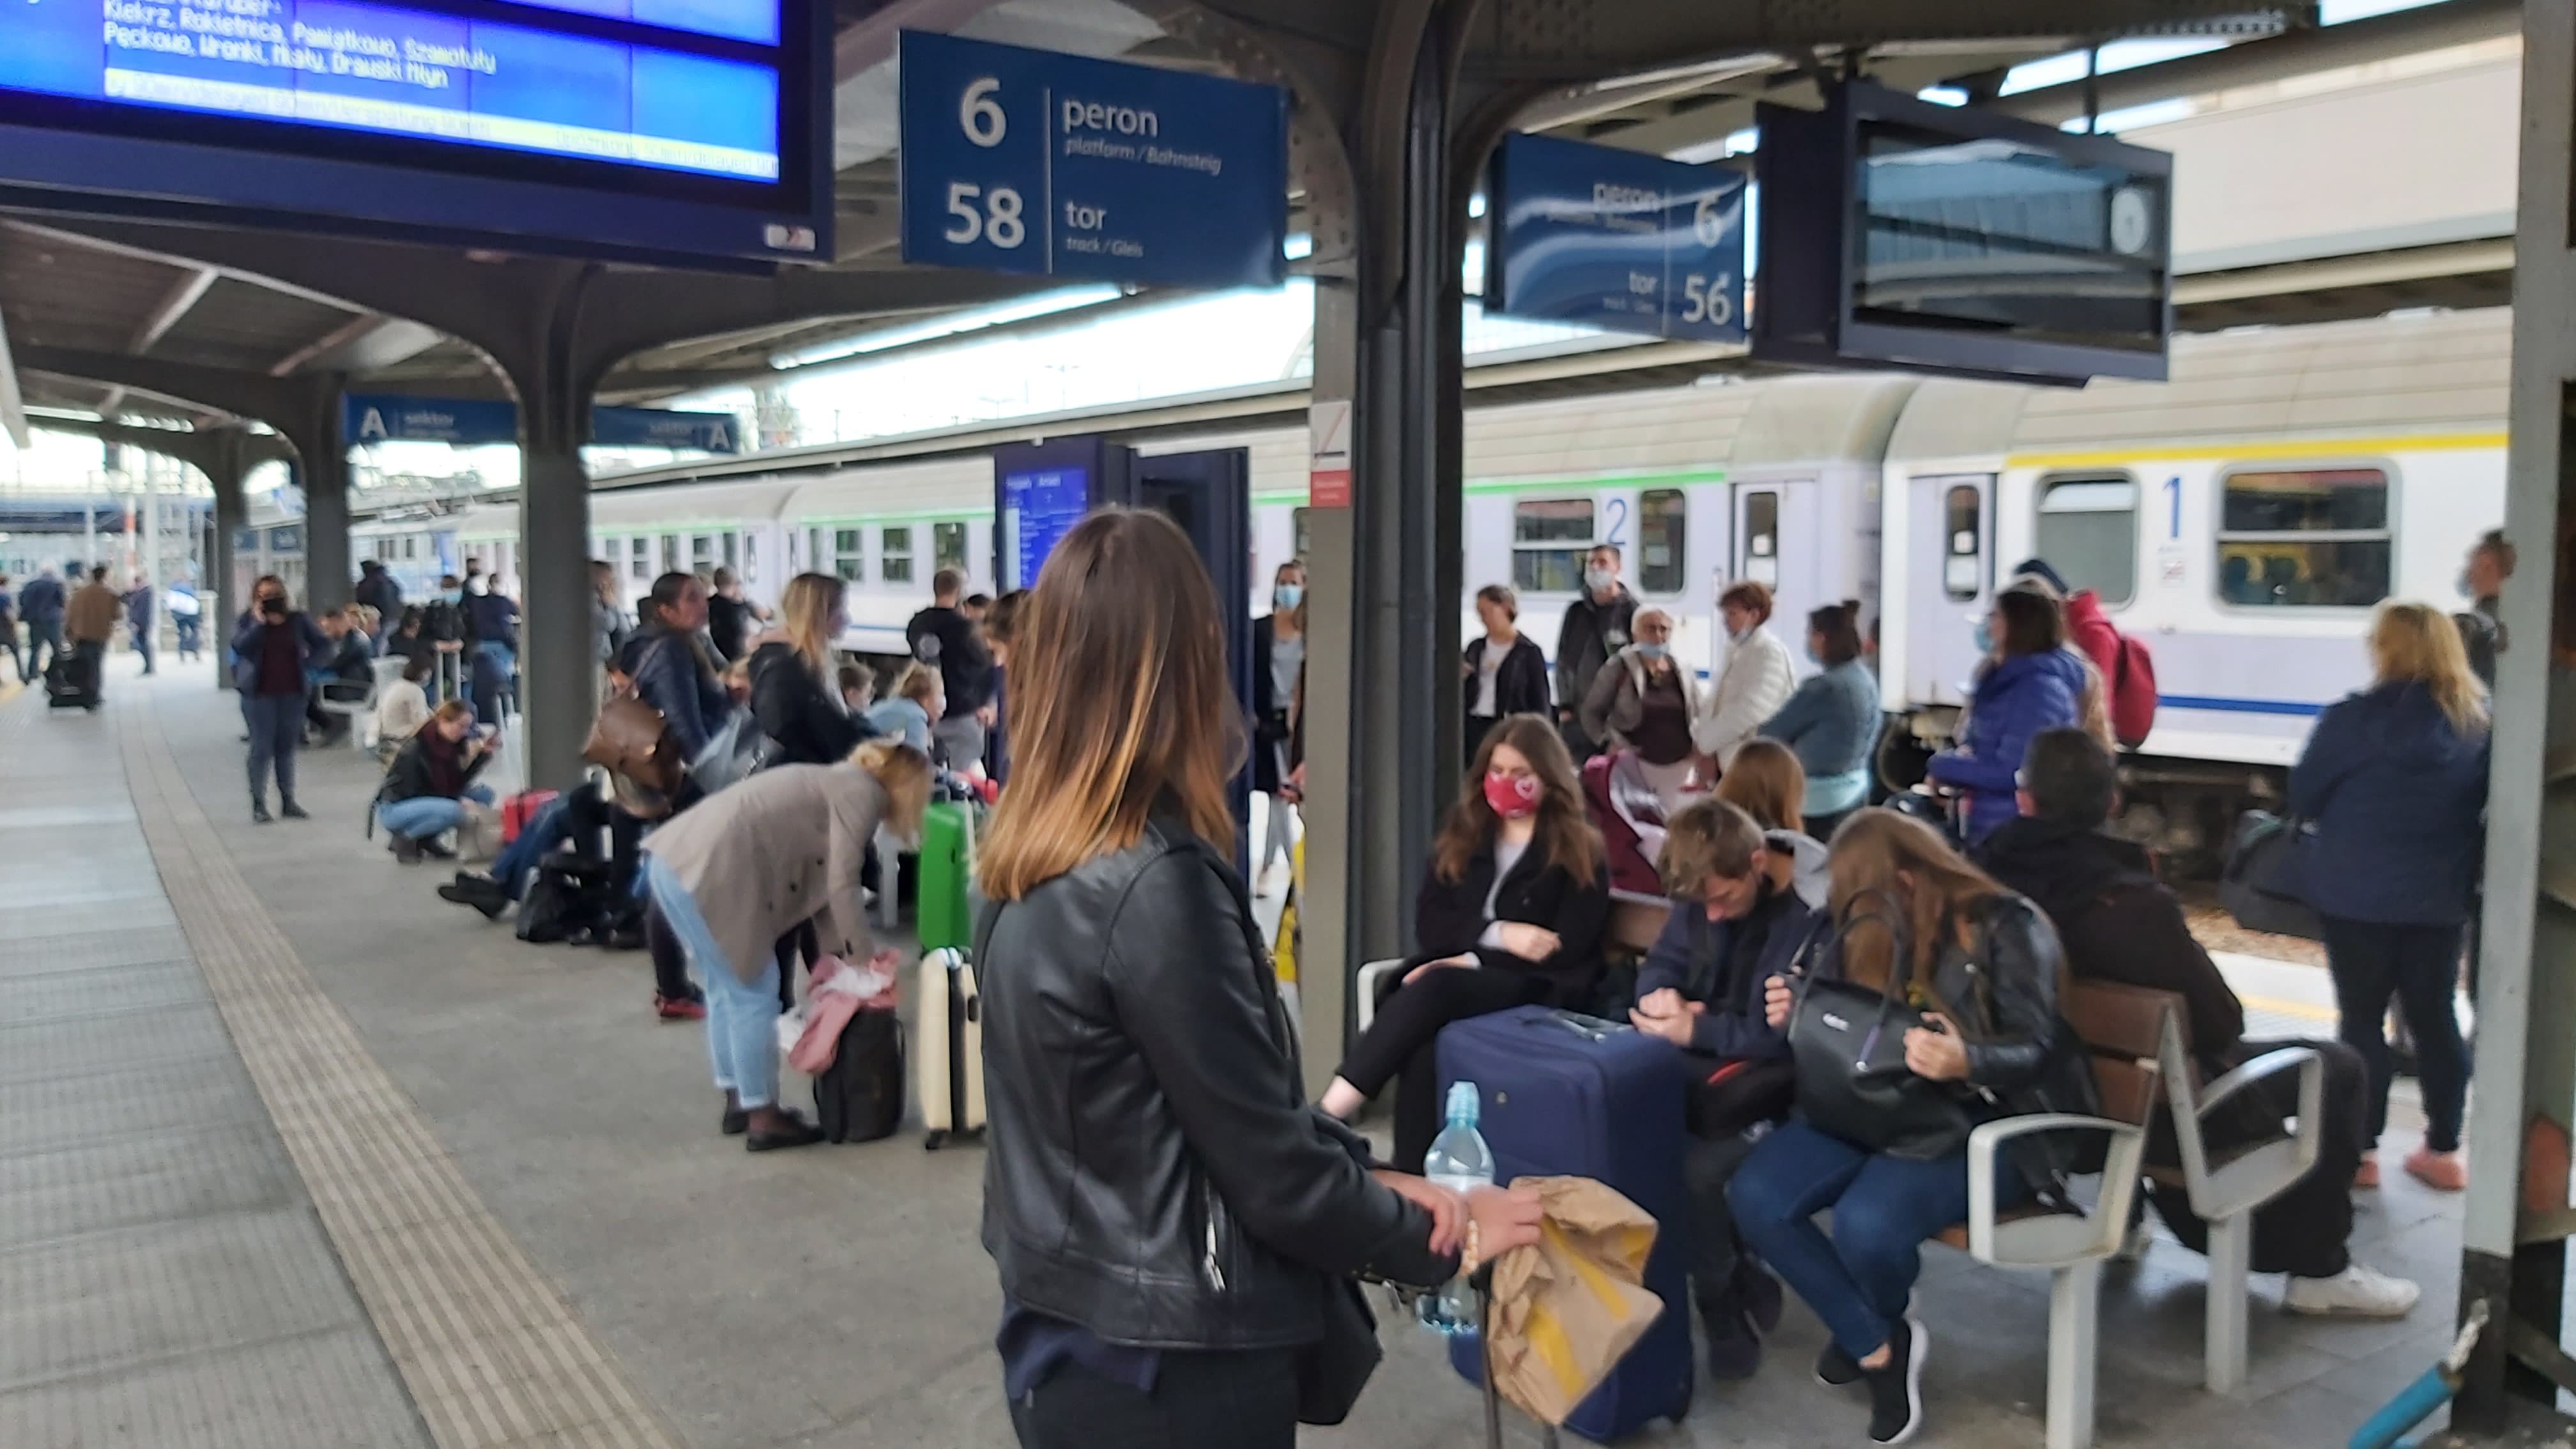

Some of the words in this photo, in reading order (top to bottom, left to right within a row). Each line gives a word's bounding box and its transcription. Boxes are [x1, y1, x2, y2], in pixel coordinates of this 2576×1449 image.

[961, 77, 1007, 148] 6
[1062, 99, 1158, 137] peron
[1065, 136, 1135, 160] platform
[945, 183, 1025, 250] 58
[1065, 201, 1107, 231] tor
[1694, 195, 1723, 248] 6
[1629, 270, 1658, 295] tor
[1682, 273, 1732, 325] 56
[360, 406, 388, 438] A
[709, 421, 731, 450] A
[1606, 498, 1627, 547] 2
[2162, 476, 2181, 539] 1
